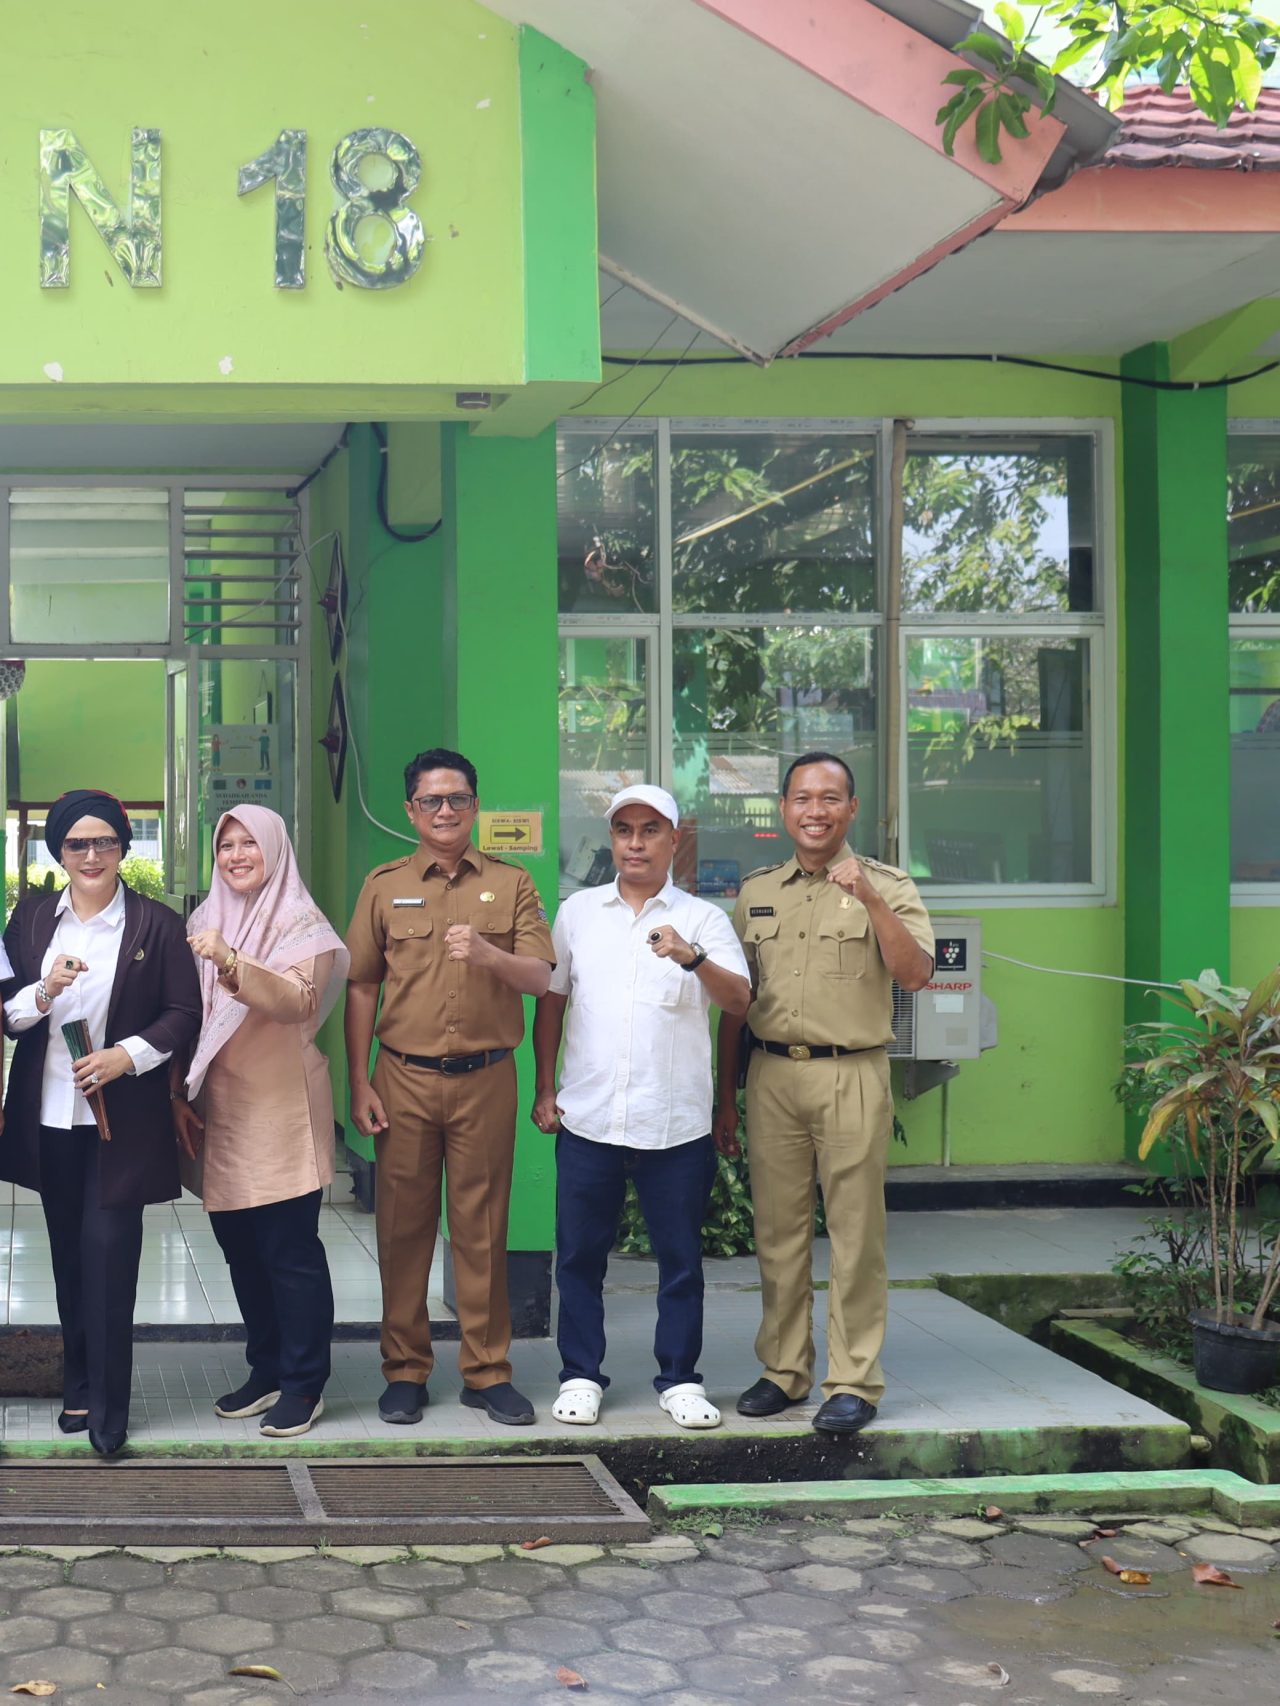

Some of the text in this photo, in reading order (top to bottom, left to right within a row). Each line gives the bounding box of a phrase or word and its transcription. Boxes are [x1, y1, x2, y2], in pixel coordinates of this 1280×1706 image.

[39, 127, 163, 289] N
[237, 127, 425, 290] 18
[926, 982, 973, 991] SHARP
